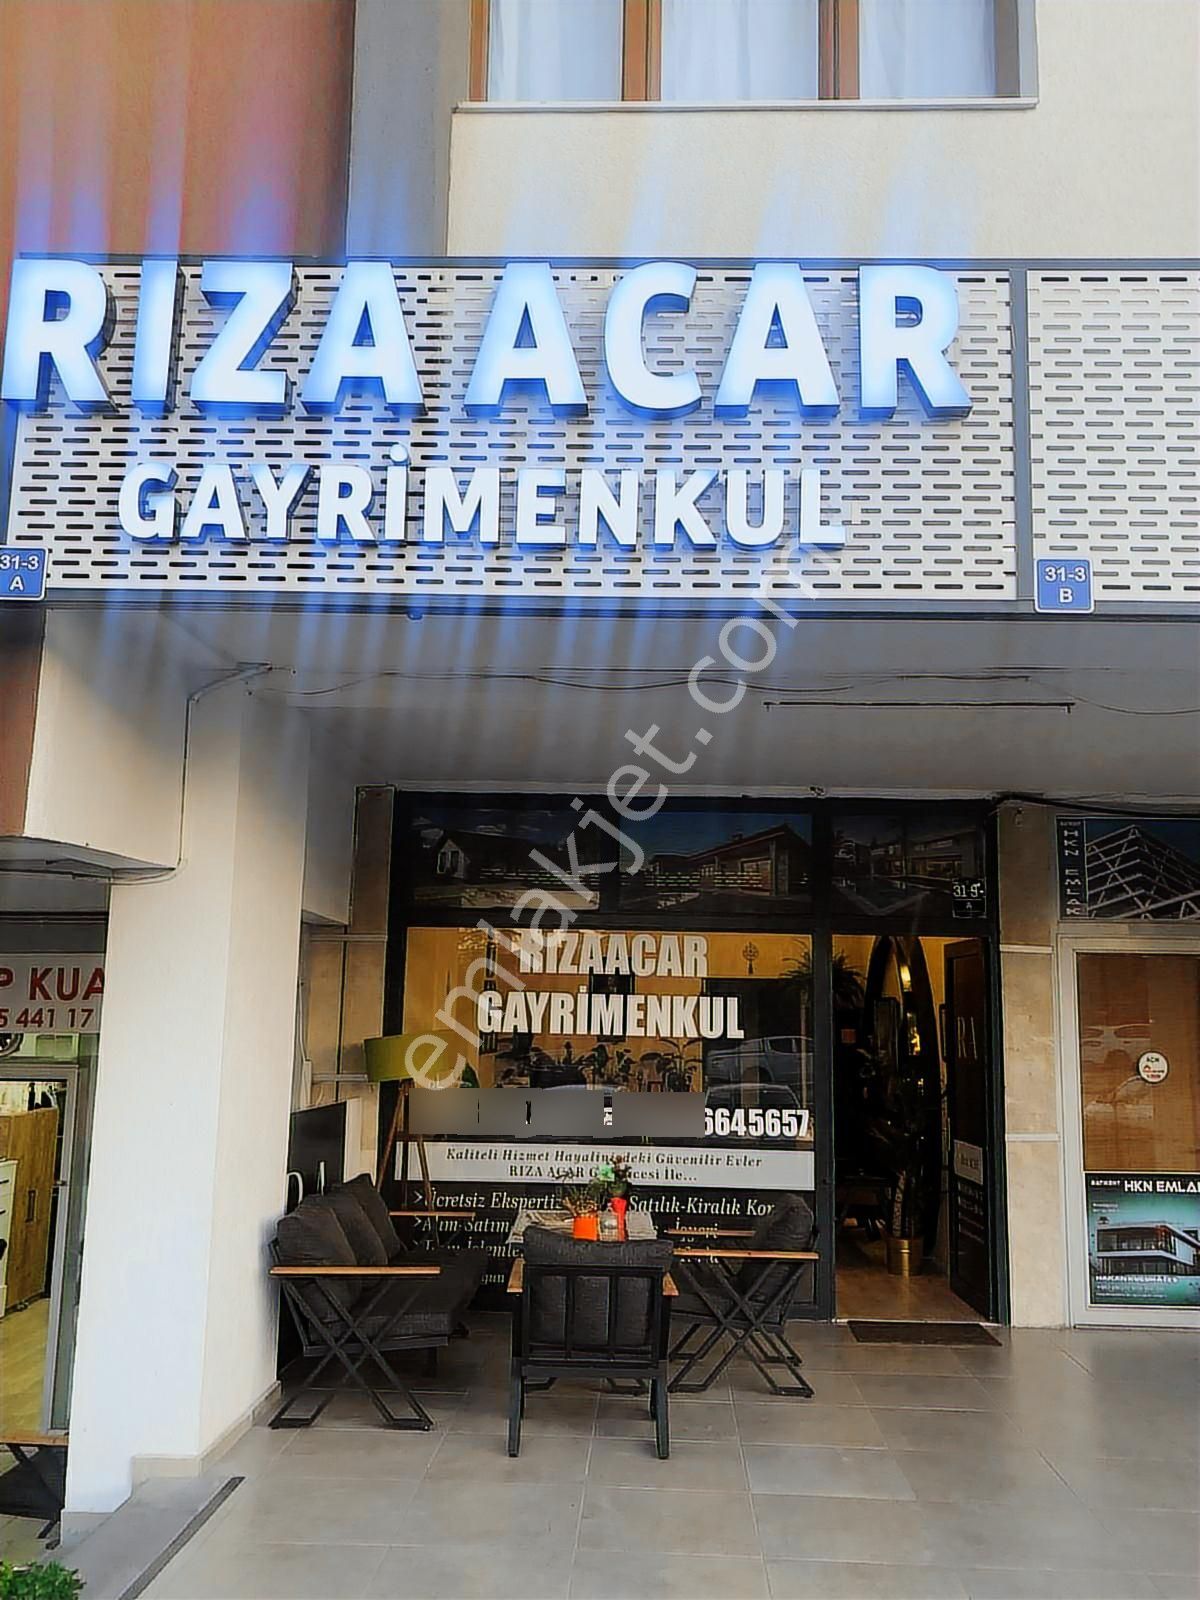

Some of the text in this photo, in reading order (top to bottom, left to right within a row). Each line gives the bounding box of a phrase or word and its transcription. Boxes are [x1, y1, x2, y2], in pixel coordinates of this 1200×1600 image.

[1, 258, 972, 416] RIZA ACAR
[118, 443, 847, 549] GAYRİMENKUL
[0, 554, 39, 571] 31-3
[1044, 566, 1087, 582] 31-3
[9, 575, 24, 592] A
[1060, 588, 1073, 603] B
[15, 1007, 56, 1028] 441
[68, 1008, 95, 1028] 17
[477, 985, 745, 1039] GAYRİMENKUL
[446, 1147, 763, 1169] Kaliteli Hizmet Hayalinideki Güvenilir Evler
[509, 1165, 544, 1178] RIZA
[1124, 1180, 1153, 1192] HKN
[490, 1191, 563, 1210] Ekspertiz
